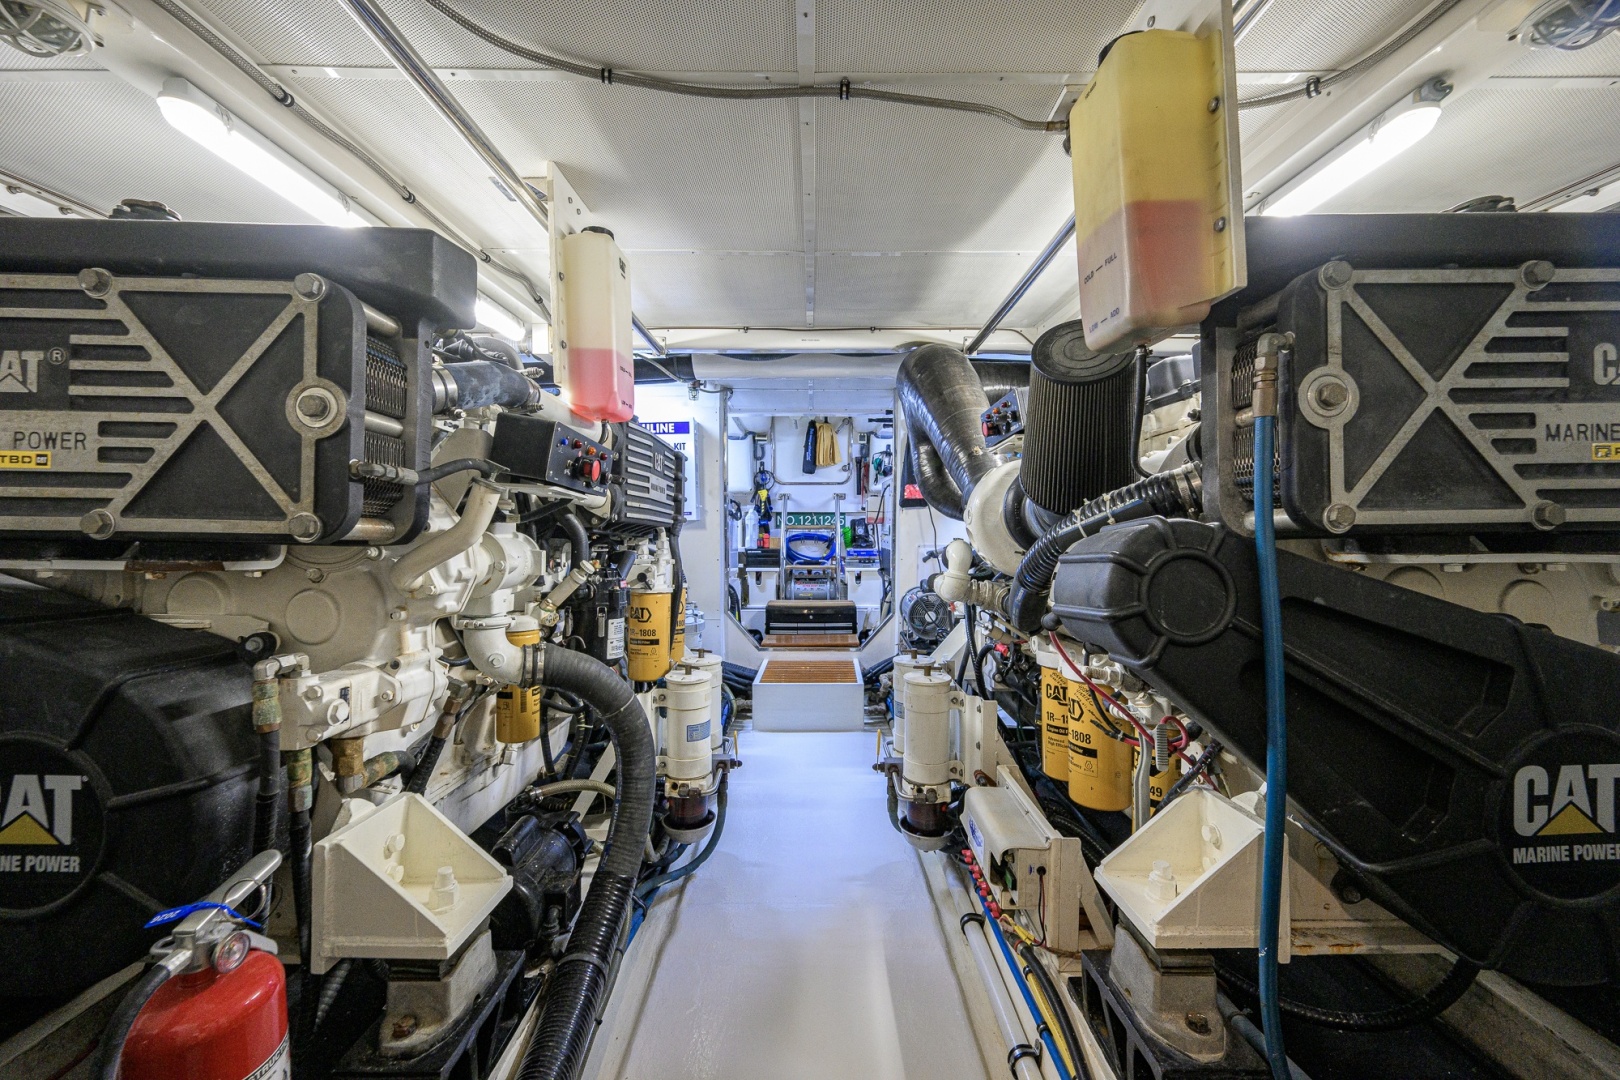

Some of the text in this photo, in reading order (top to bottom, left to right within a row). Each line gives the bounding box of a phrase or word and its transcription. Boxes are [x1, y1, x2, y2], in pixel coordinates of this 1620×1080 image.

[1104, 252, 1117, 266] FULL
[0, 350, 44, 393] AT
[14, 431, 87, 450] POWER
[1545, 423, 1620, 441] MARINE
[673, 442, 686, 451] KIT
[1046, 683, 1068, 702] CAT
[1068, 729, 1092, 745] -1808
[1149, 785, 1163, 798] 49
[1513, 763, 1620, 837] CAT
[0, 773, 82, 846] AT
[1513, 845, 1570, 864] MARINE
[24, 855, 80, 873] POWER
